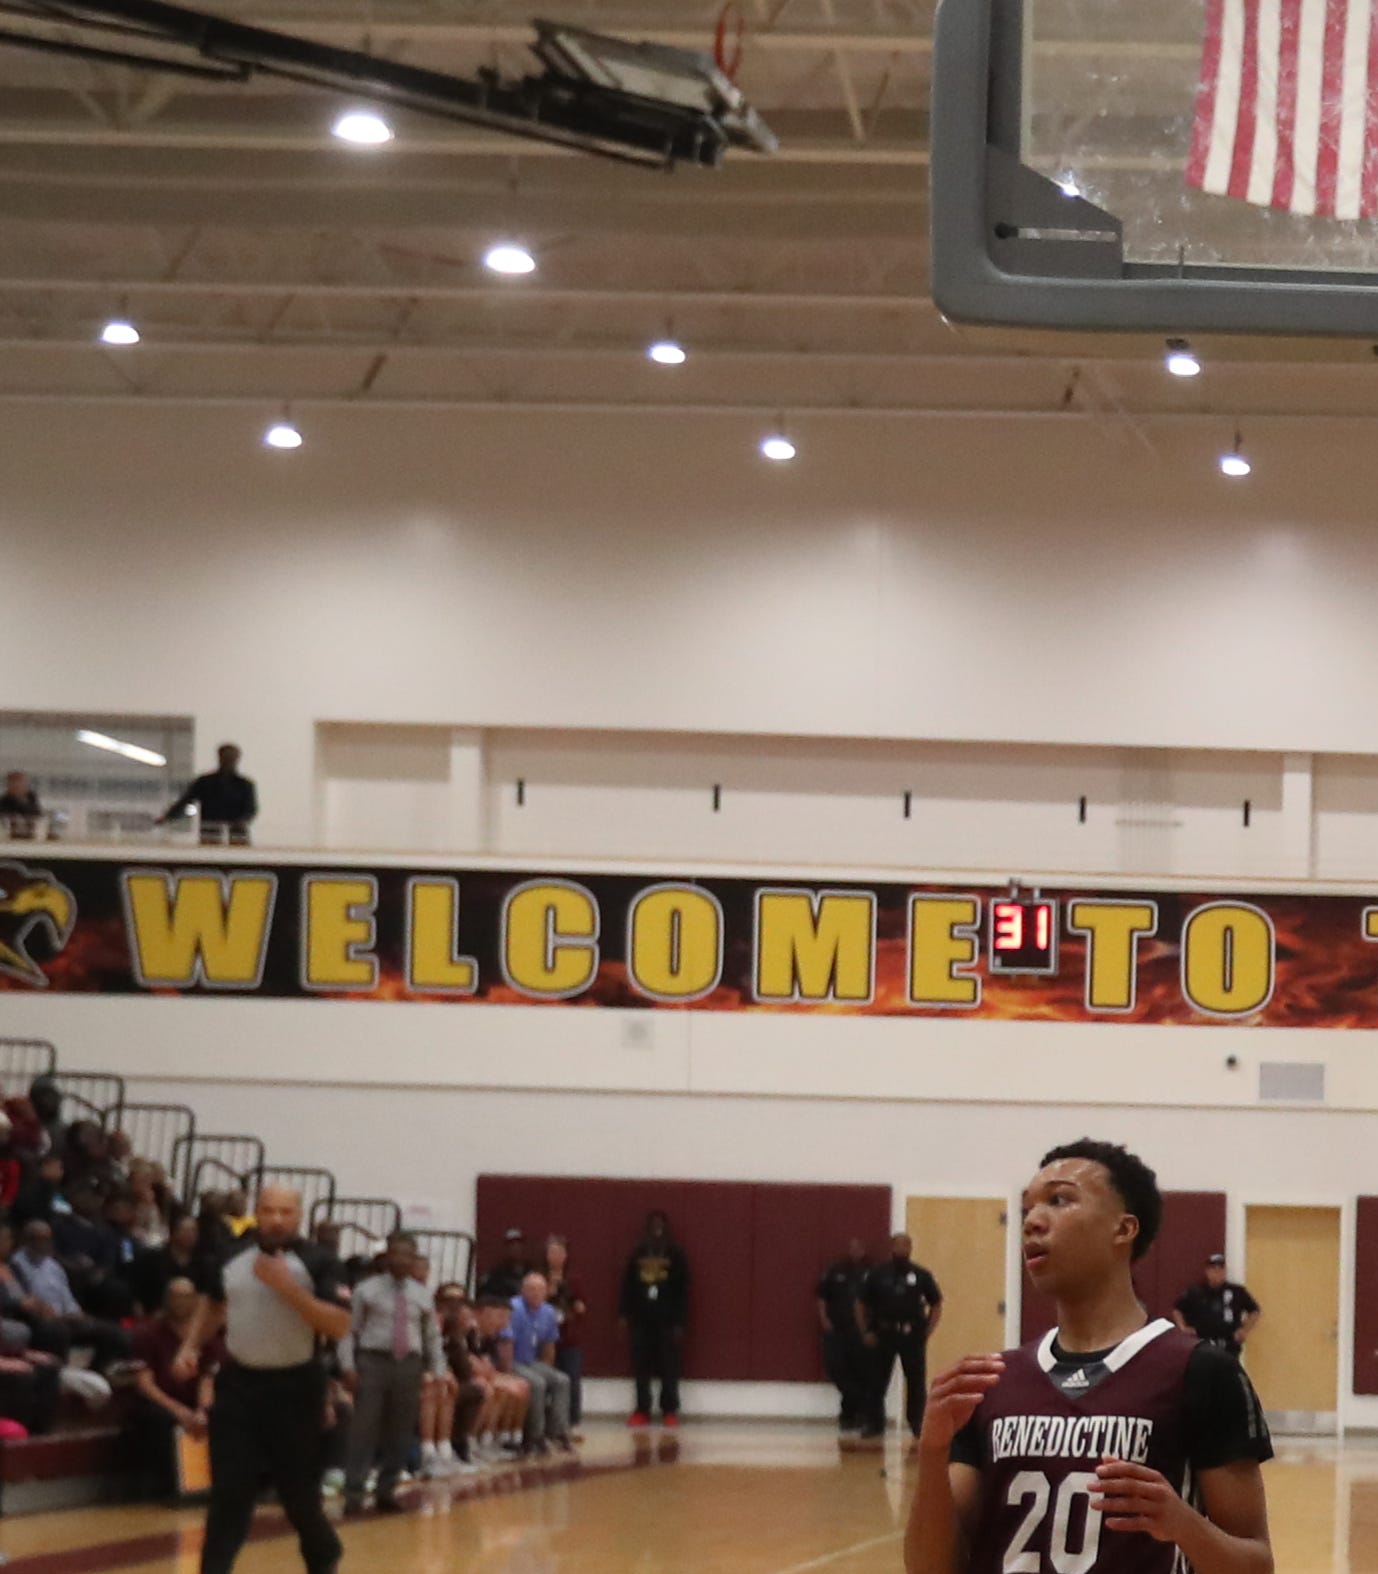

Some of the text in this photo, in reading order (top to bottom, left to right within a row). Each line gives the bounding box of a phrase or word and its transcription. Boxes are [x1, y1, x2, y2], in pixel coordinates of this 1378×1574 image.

[121, 870, 982, 1011] WELCOME
[1069, 899, 1277, 1019] TO
[994, 905, 1049, 950] 31
[992, 1415, 1153, 1463] BENEDICTINE
